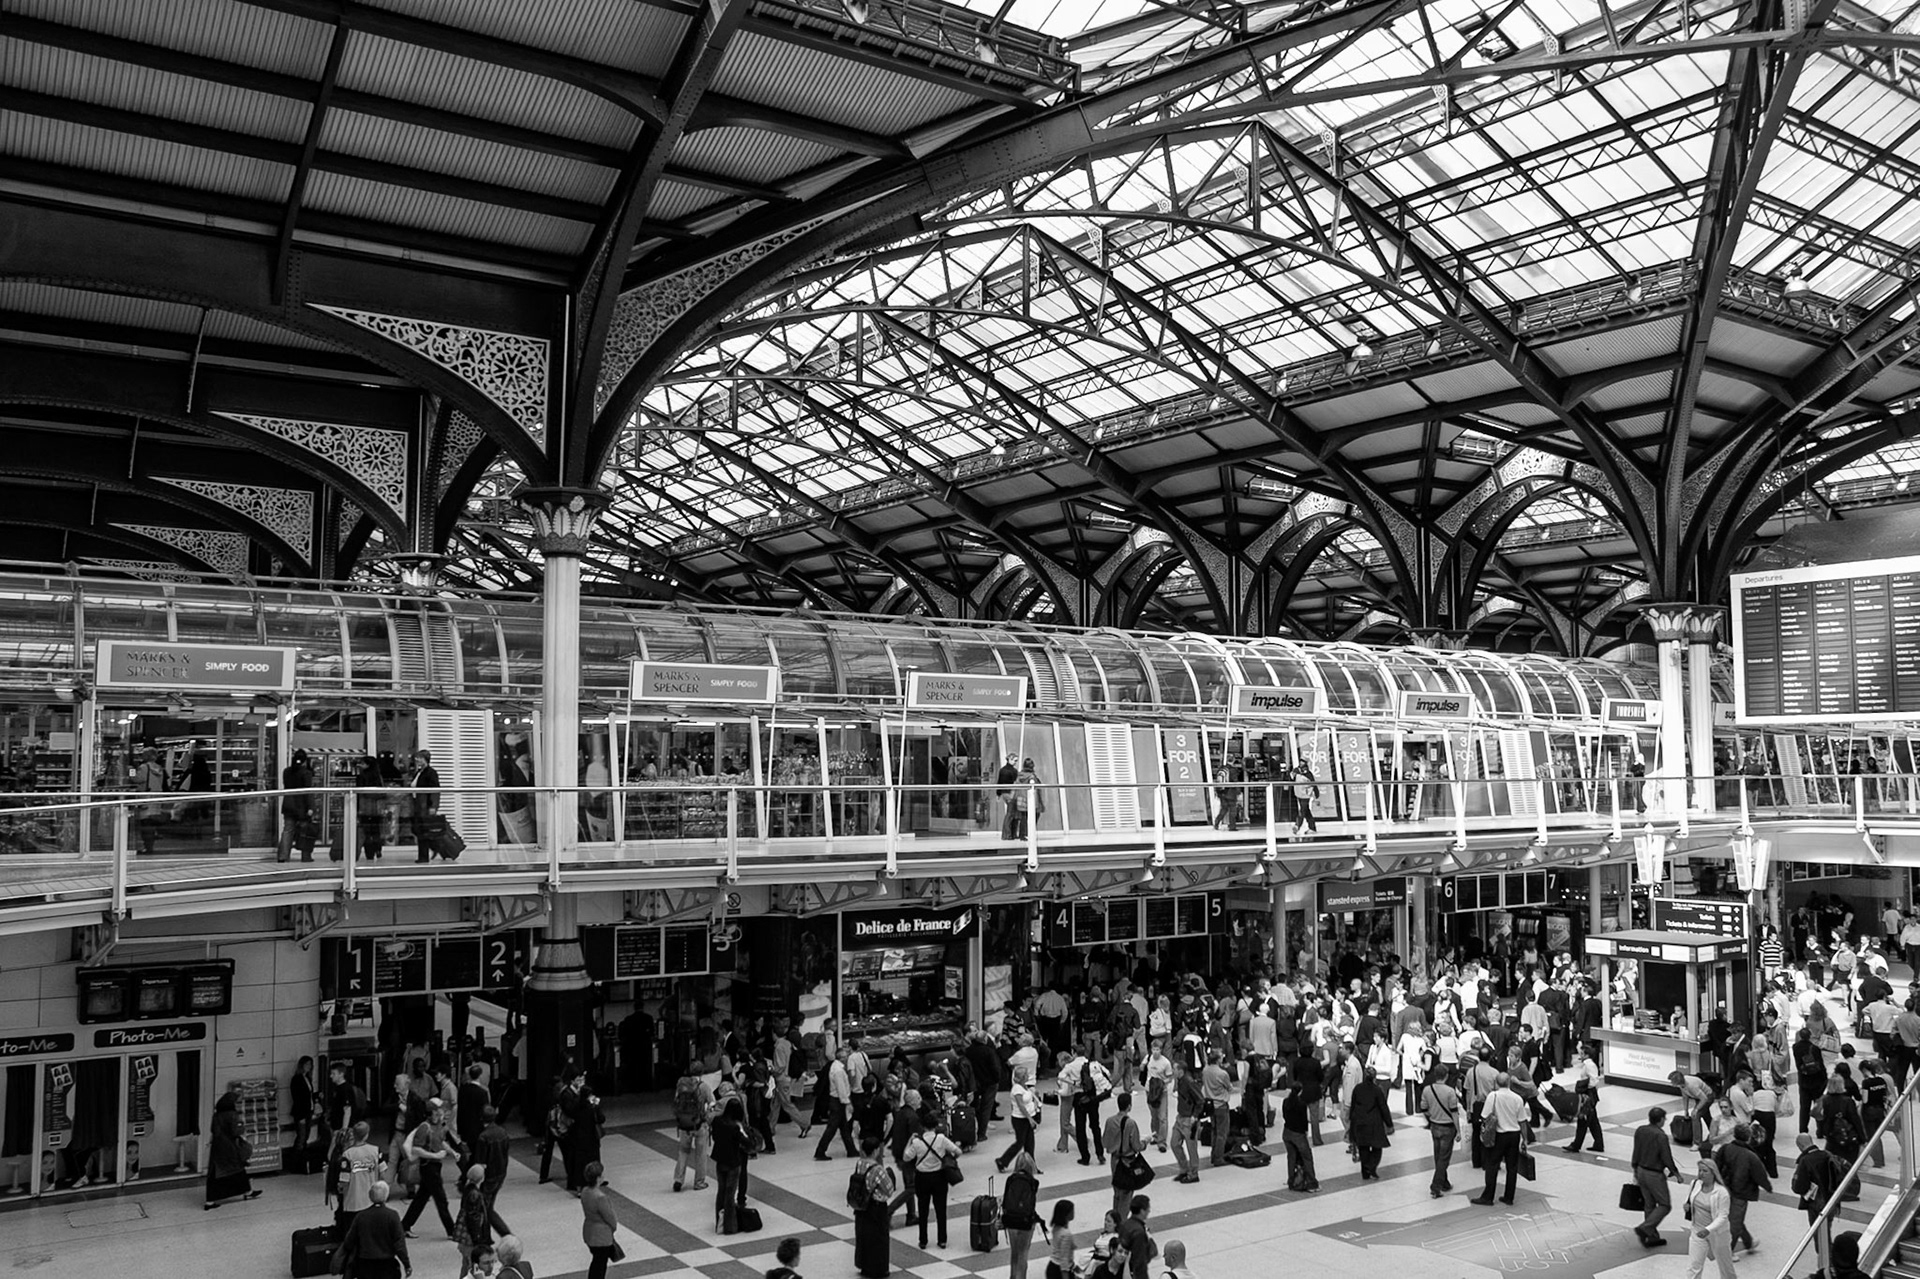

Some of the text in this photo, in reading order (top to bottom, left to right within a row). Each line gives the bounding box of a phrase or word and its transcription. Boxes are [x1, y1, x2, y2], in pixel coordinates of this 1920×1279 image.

[1745, 575, 1783, 584] Departures
[127, 651, 191, 664] MARKS &
[127, 665, 190, 679] SPENCER
[205, 661, 270, 673] SIMPLY FOOD
[653, 671, 700, 681] MARKS &
[653, 683, 699, 693] SPENCER
[710, 679, 758, 688] SIMPLY FOOD
[925, 681, 965, 690] MARKS &
[925, 692, 963, 701] SPENCER
[1251, 692, 1303, 710] impulse
[1416, 698, 1460, 713] impulse
[1176, 734, 1187, 747] 3
[1349, 737, 1358, 748] 3
[1460, 736, 1468, 748] 3
[1168, 750, 1198, 763] FOR
[1302, 751, 1328, 763] FOR
[1343, 751, 1368, 763] FOR
[1455, 750, 1475, 761] FOR
[1179, 766, 1190, 779] 2
[1352, 766, 1361, 778] 2
[1548, 874, 1557, 890] 7
[1444, 881, 1453, 898] 6
[1327, 895, 1370, 905] stansted express
[1211, 898, 1222, 917] 5
[1056, 908, 1069, 928] 4
[855, 918, 951, 935] Delice de France
[1665, 919, 1682, 927] Tickets
[1688, 922, 1716, 930] Information
[490, 941, 507, 965] 2
[1619, 944, 1650, 953] Information
[351, 948, 362, 974] 1
[109, 1026, 191, 1045] Photo-Me
